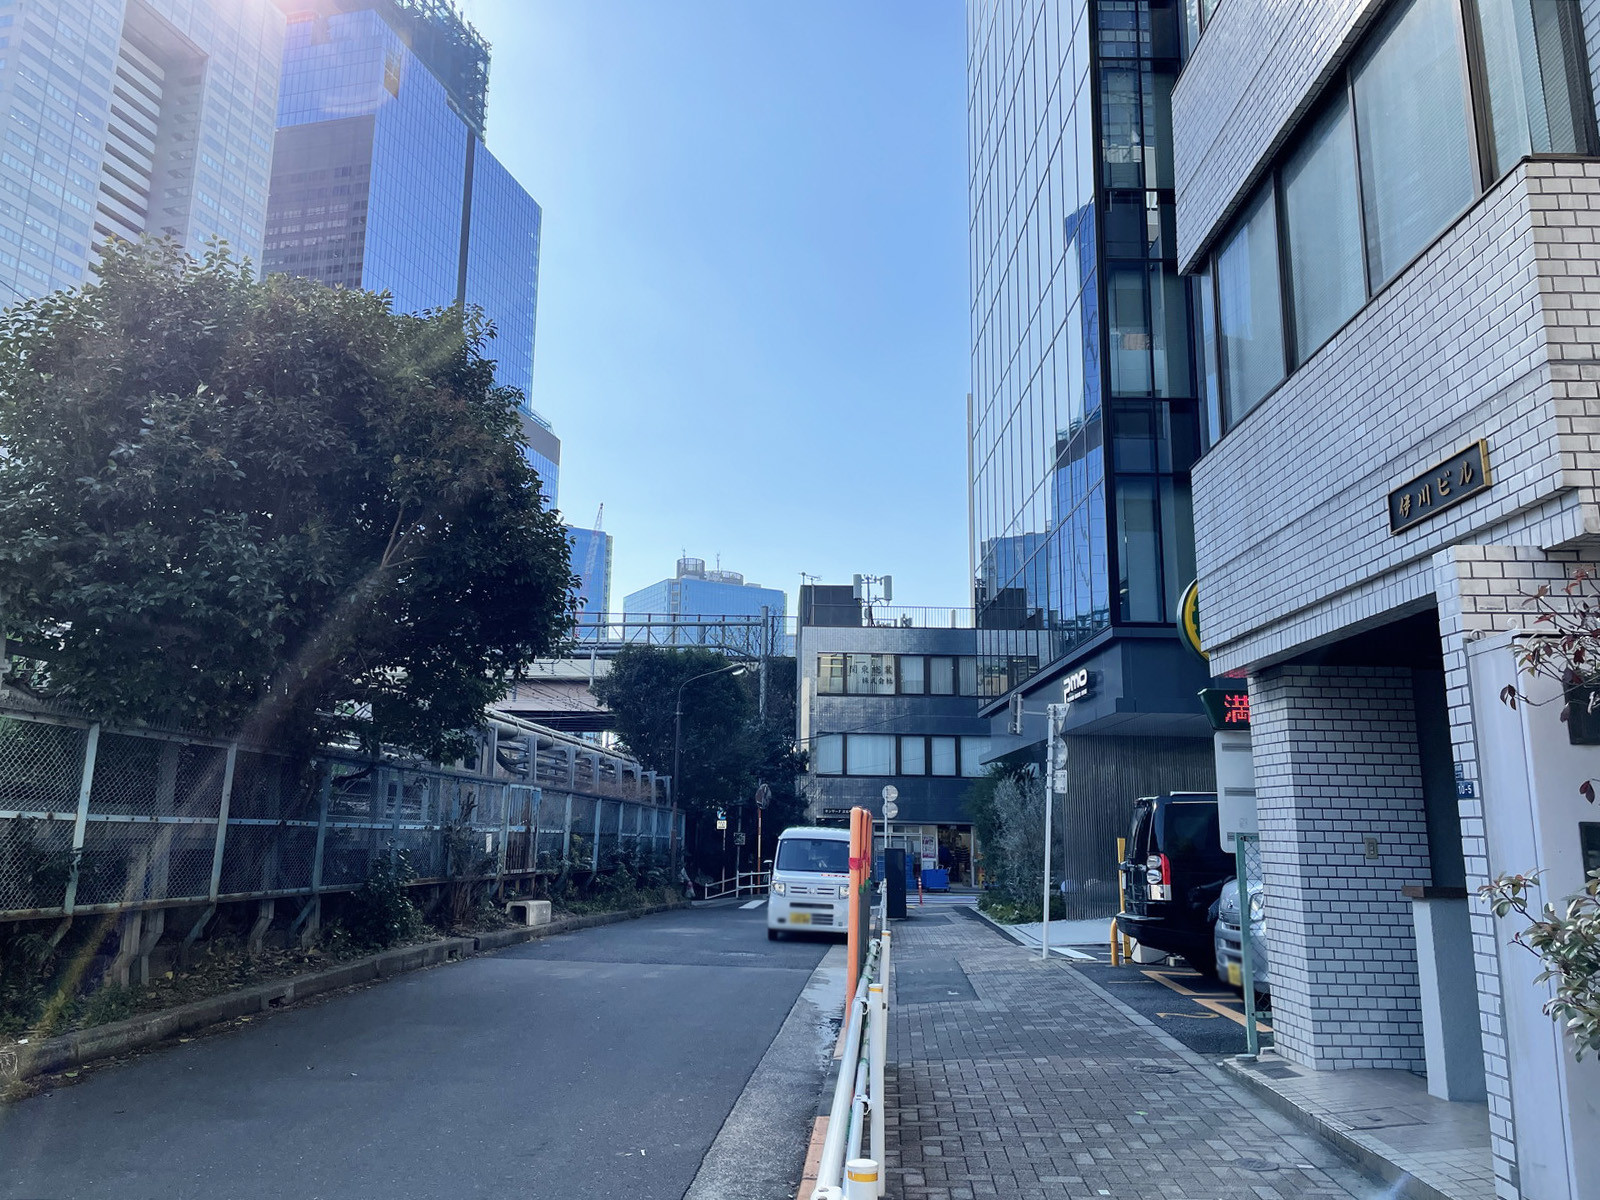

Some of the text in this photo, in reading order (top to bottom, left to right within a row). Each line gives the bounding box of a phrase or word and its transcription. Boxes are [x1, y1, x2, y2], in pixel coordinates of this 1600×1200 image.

[1398, 461, 1474, 519] 伊川ビル
[862, 676, 894, 685] 株式会社
[1224, 693, 1250, 723] 満
[1458, 784, 1473, 795] 10-5
[1155, 1011, 1221, 1019] 2
